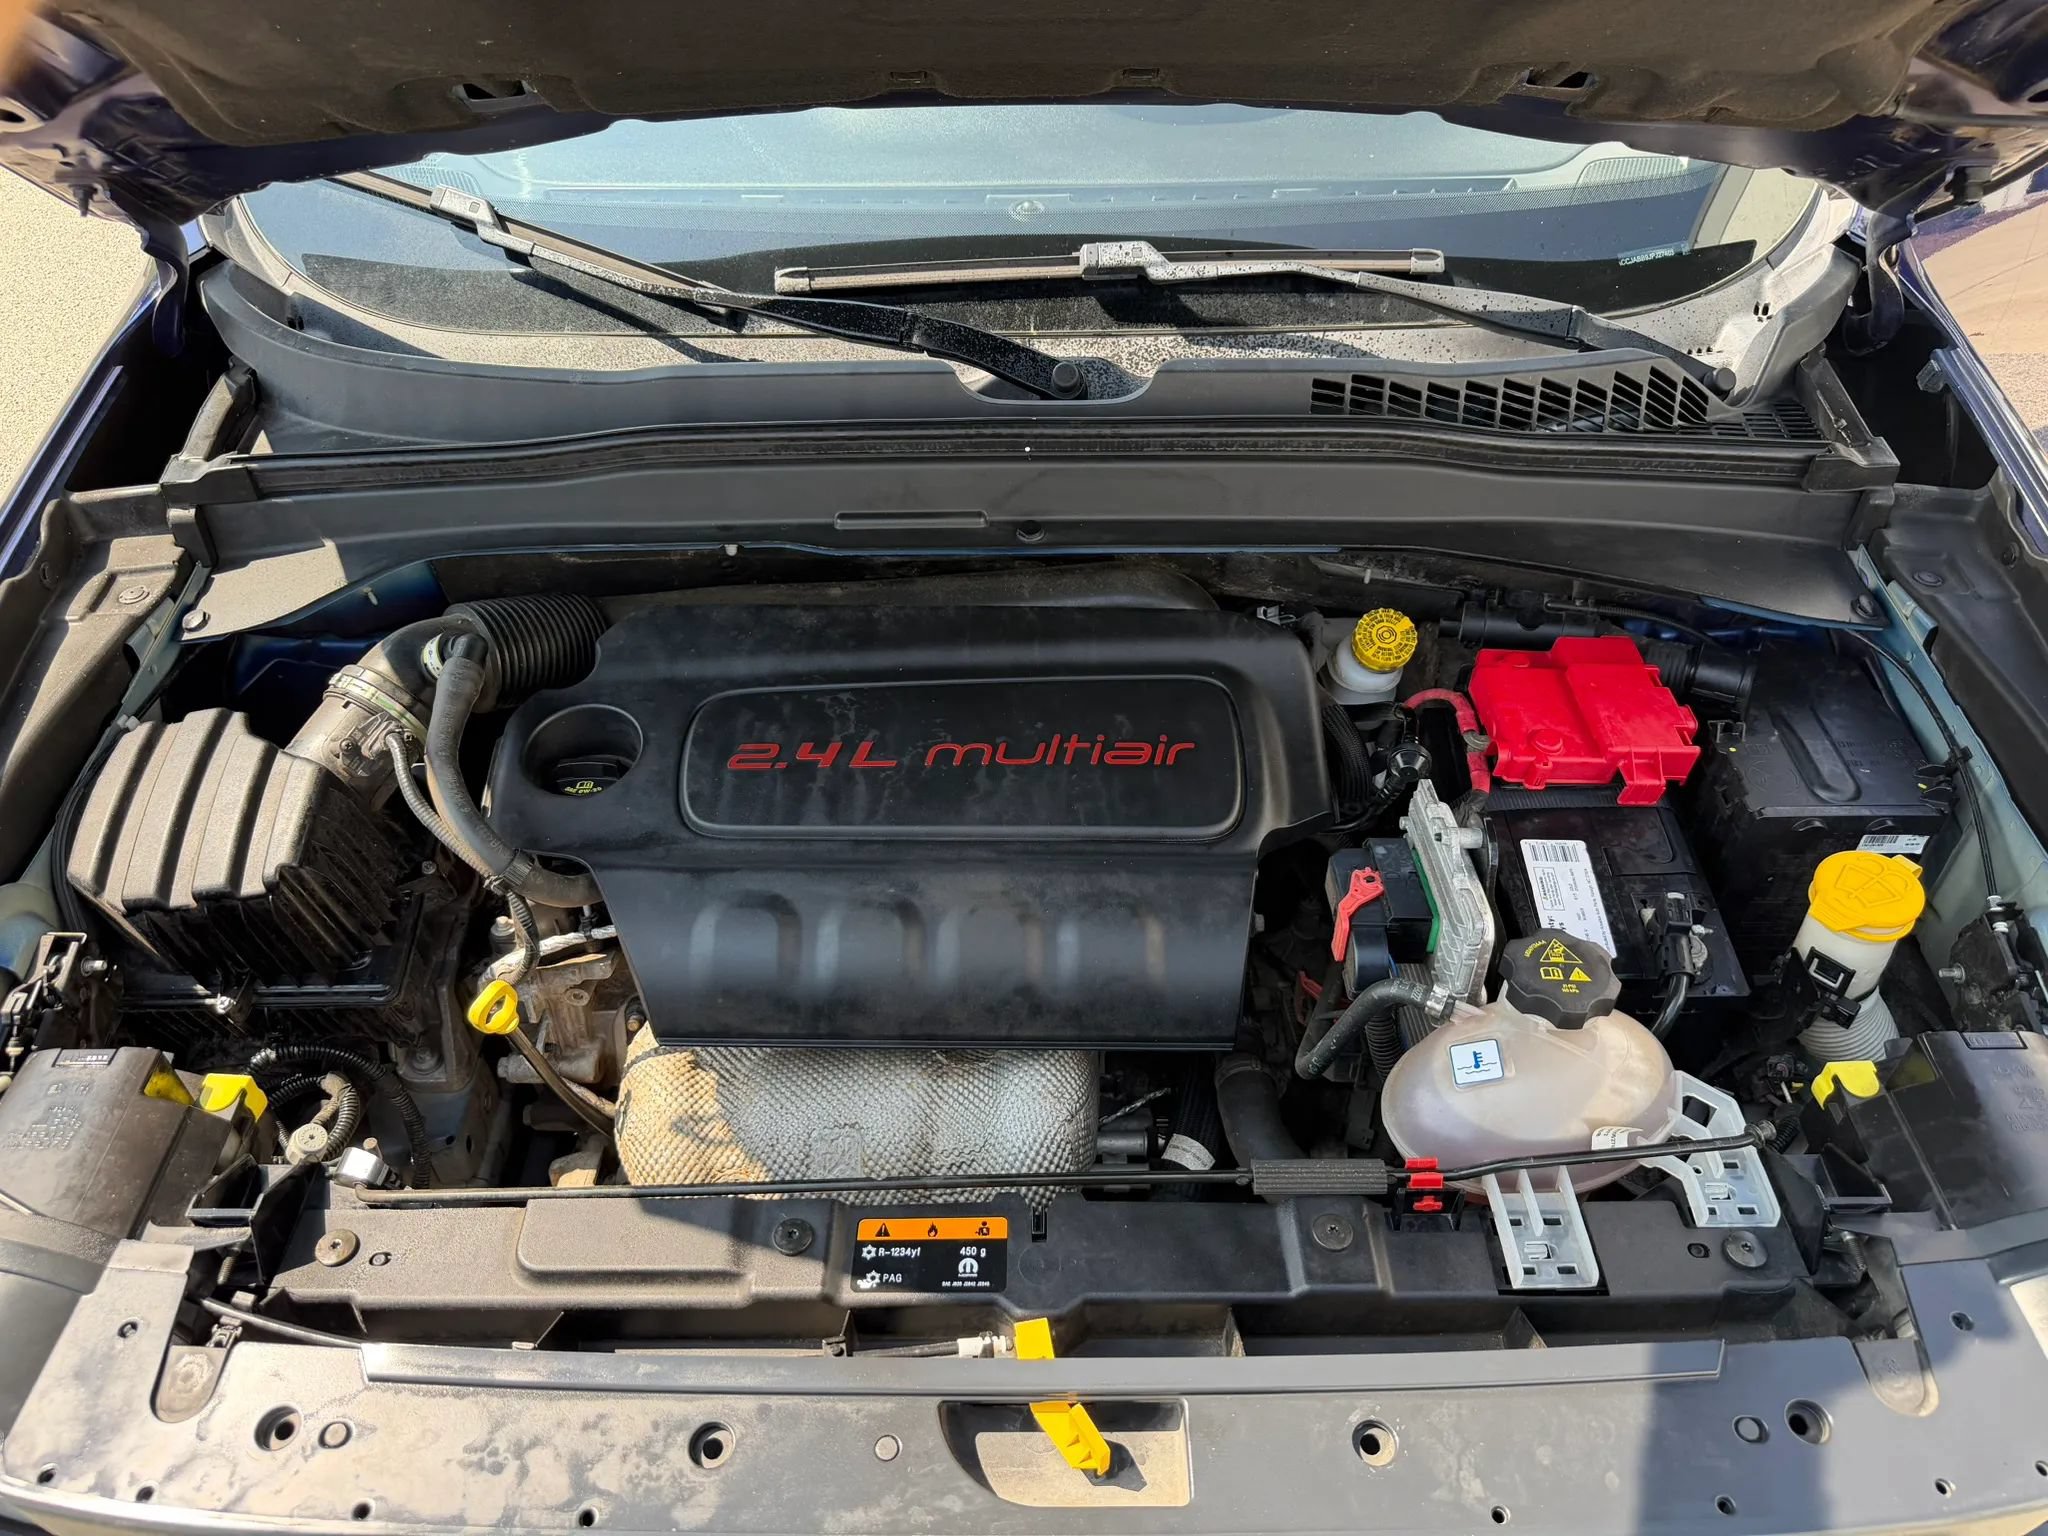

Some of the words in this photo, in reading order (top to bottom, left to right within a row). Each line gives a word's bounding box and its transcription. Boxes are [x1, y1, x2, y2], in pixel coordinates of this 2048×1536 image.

[925, 734, 1196, 766] multiair
[878, 1247, 920, 1258] R-1234yf
[960, 1246, 976, 1256] 450
[980, 1248, 986, 1258] g
[882, 1274, 902, 1283] PAG
